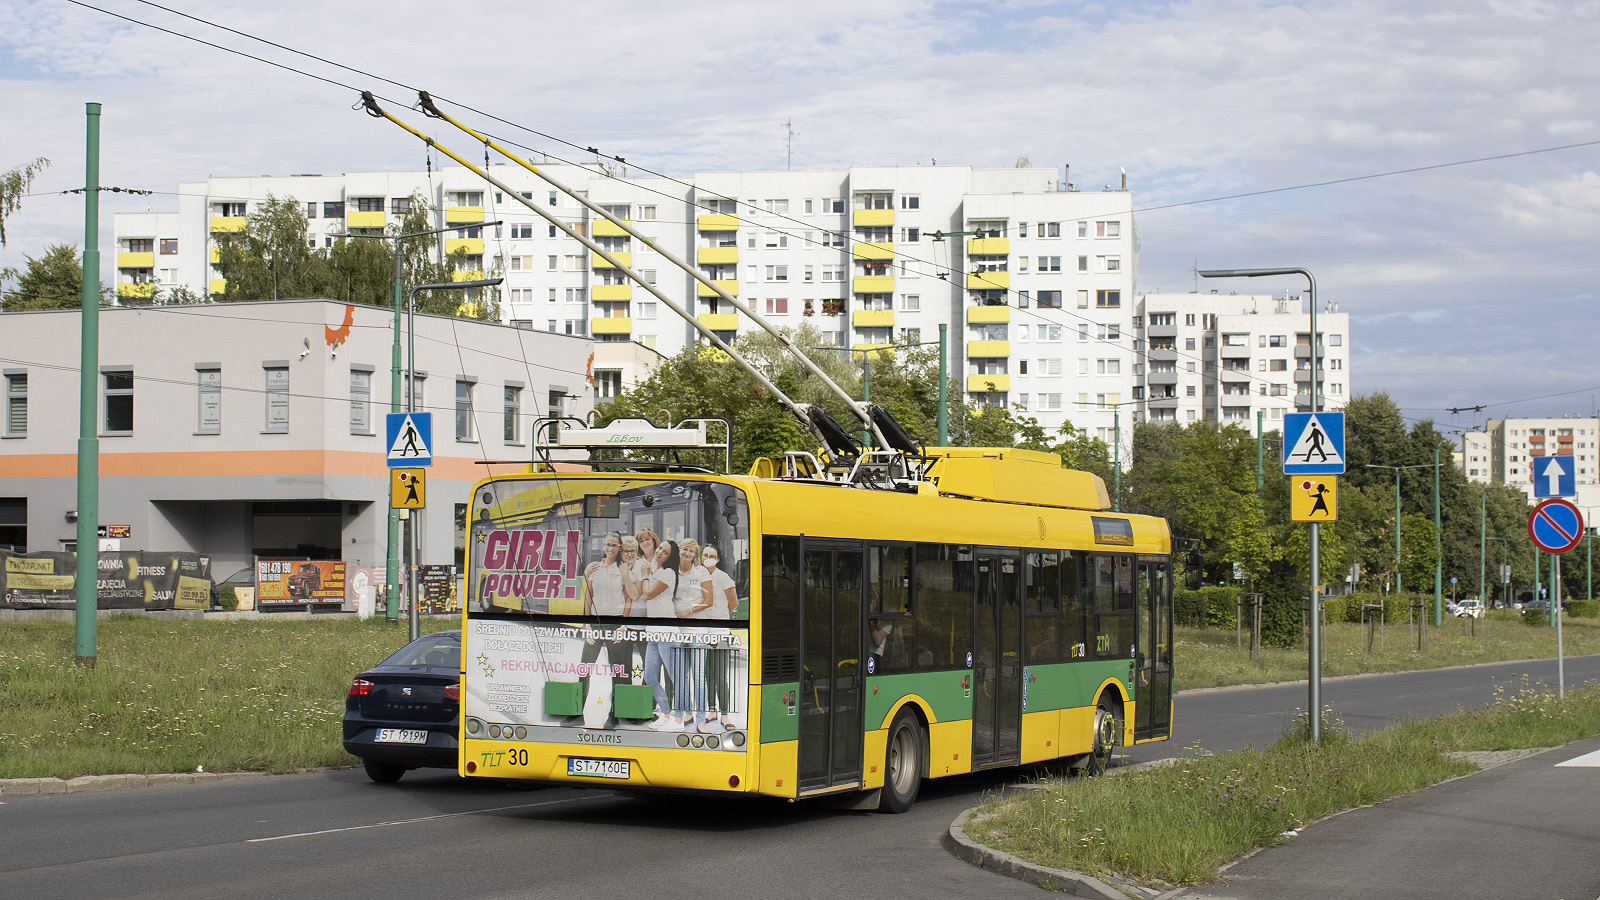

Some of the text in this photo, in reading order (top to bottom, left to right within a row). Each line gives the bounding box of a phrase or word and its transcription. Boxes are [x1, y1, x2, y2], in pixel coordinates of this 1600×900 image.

[30, 562, 51, 571] PUNKT
[137, 566, 166, 576] FITNESS
[44, 579, 54, 587] DO
[476, 622, 742, 646] ŚREDNIO CO CZWARTY TROLEJBUS PROWADZI KOBIETA
[485, 639, 564, 654] DOŁĄCZ DO NICH!
[1078, 642, 1085, 658] 30
[501, 660, 629, 678] REKRUTACJA@TLT.PL
[487, 683, 531, 694] UPRAWNIENIA
[381, 730, 396, 740] ST
[577, 733, 622, 744] SOLARIS
[480, 748, 528, 768] TLT 30
[575, 760, 628, 774] ST 7160E
